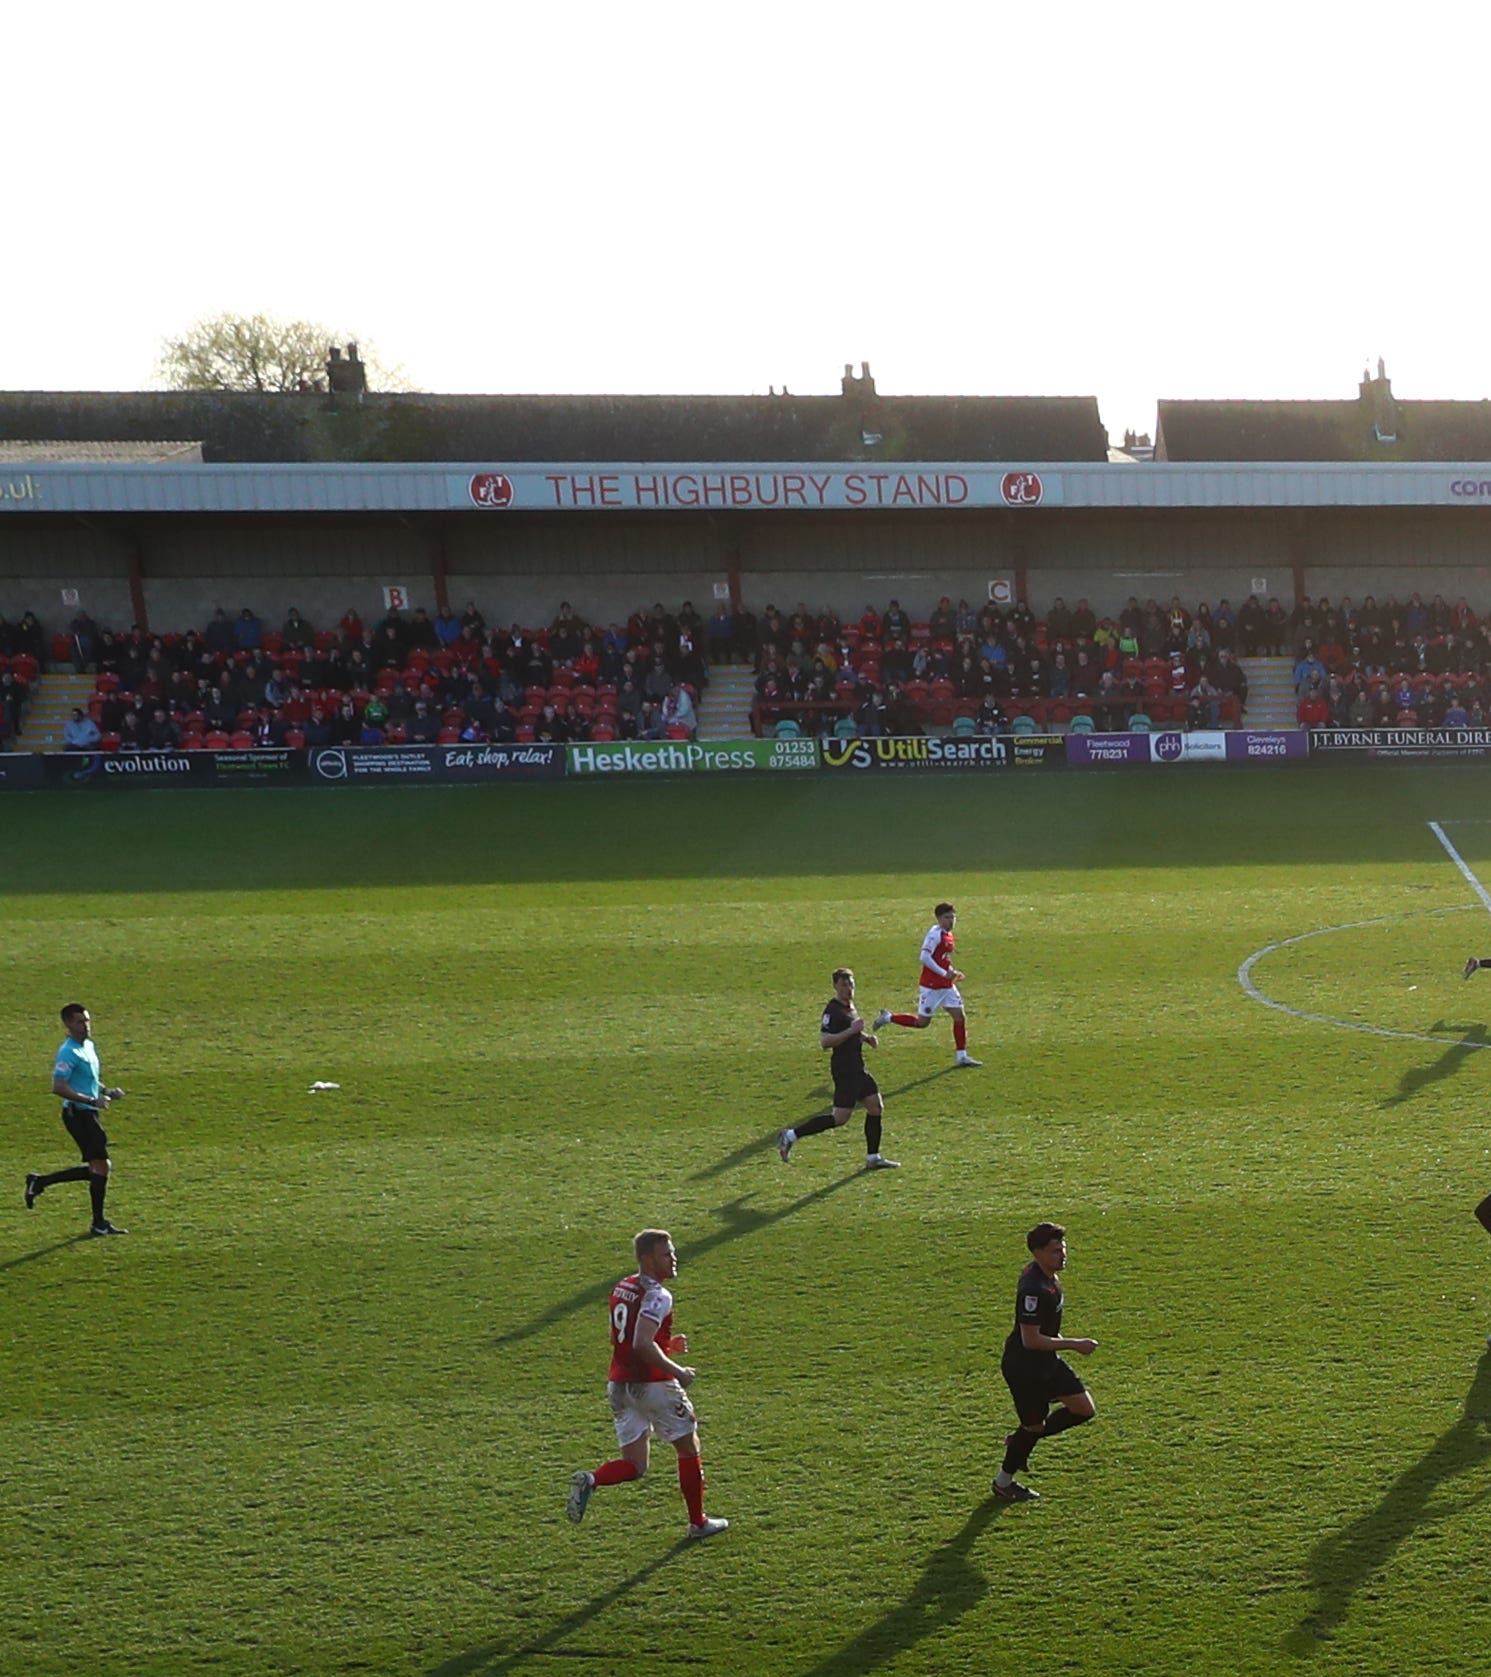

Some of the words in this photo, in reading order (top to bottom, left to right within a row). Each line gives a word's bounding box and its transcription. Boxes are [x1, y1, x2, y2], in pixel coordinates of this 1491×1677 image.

[545, 476, 622, 505] THE
[634, 475, 832, 505] HIGHBURY
[844, 474, 968, 505] STAND
[1086, 739, 1131, 748] Fleetwood
[1387, 731, 1453, 745] FUNERAL
[775, 741, 814, 754] 01253
[876, 737, 1006, 761] UtiliSearch
[1089, 749, 1128, 759] 778231
[1247, 745, 1287, 755] 824216
[104, 755, 190, 773] evolution
[445, 750, 474, 769] Eat,
[476, 748, 510, 768] shop,
[511, 747, 554, 765] relax!
[769, 755, 816, 768] 875484
[613, 1302, 629, 1344] 9
